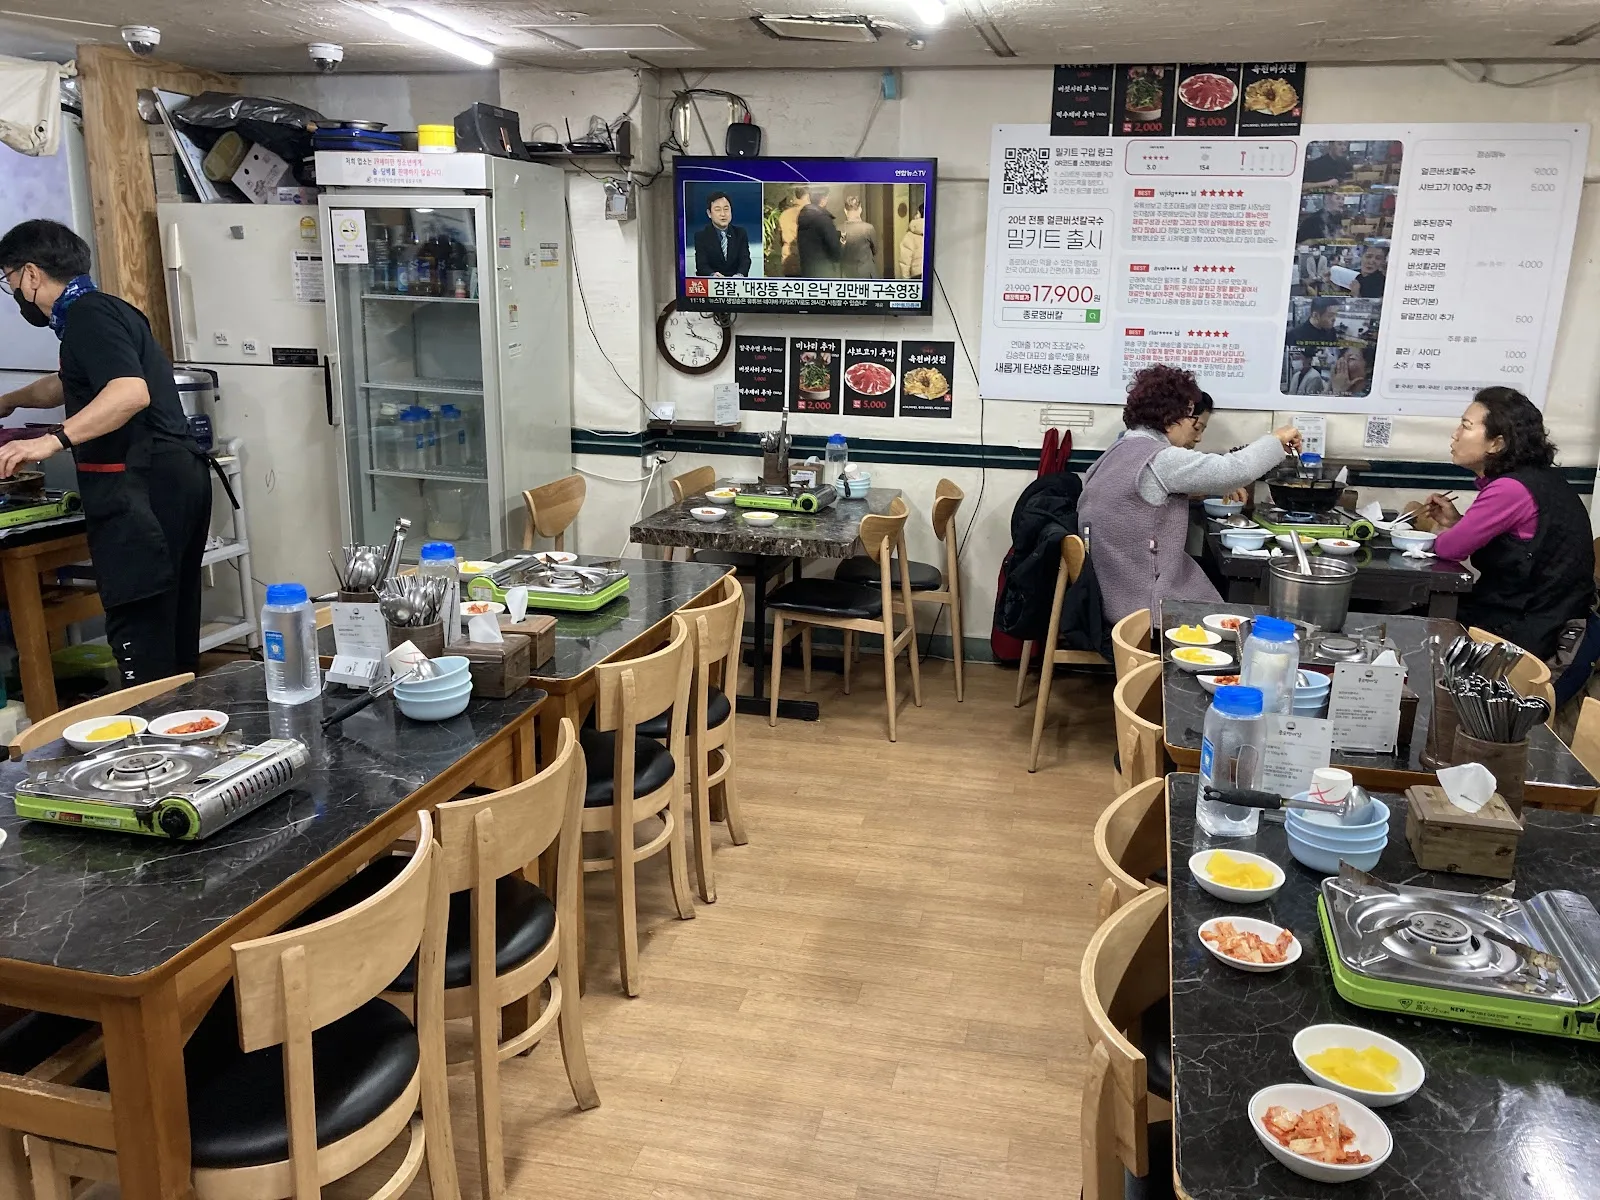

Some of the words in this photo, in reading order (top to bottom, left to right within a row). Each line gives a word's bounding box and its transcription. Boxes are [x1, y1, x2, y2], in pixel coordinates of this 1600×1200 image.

[1082, 110, 1095, 118] 추가
[1199, 117, 1226, 128] 5,000
[1134, 122, 1162, 132] 2,000
[1056, 148, 1078, 156] 밀키트
[1081, 148, 1096, 157] 구입
[1098, 148, 1112, 157] 링크
[358, 158, 372, 166] 업소는
[1421, 168, 1476, 176] 얼큰버섯칼국수
[1453, 184, 1472, 193] 100g
[1475, 184, 1492, 192] 추가
[1008, 216, 1026, 224] 20년
[1028, 216, 1044, 224] 전통
[1047, 216, 1104, 226] 얼큰버섯칼국수
[1414, 220, 1452, 228] 배추된장국
[1008, 229, 1060, 249] 밀키트
[1066, 229, 1102, 250] 출시
[1412, 234, 1434, 242] 미역국
[714, 282, 740, 298] 검찰,
[742, 282, 780, 298] '대장동
[782, 283, 804, 298] 수익
[807, 282, 834, 298] 은닉'
[836, 283, 869, 299] 김만배
[872, 284, 920, 300] 구속영장
[1404, 284, 1435, 292] 버섯라면
[1033, 286, 1100, 304] 17,900원
[1402, 298, 1438, 306] 라면(기본)
[1024, 310, 1064, 320] 종로맹버칼
[1439, 314, 1454, 322] 추가
[670, 318, 678, 326] 10
[665, 331, 671, 339] 9
[717, 332, 722, 340] 3
[670, 344, 676, 352] 8
[761, 345, 772, 353] 추가
[796, 342, 818, 350] 미나리
[820, 342, 836, 352] 추가
[847, 347, 876, 358] 샤브고기
[880, 348, 895, 358] 추가
[1418, 348, 1441, 356] 사이다
[680, 354, 685, 362] 7
[692, 358, 698, 366] 6
[706, 354, 711, 362] 5
[761, 366, 772, 374] 추가
[995, 362, 1022, 374] 새롭게
[1024, 364, 1050, 374] 탄생한
[1053, 364, 1100, 376] 종로맹버칼
[1393, 362, 1408, 370] 소주
[761, 388, 772, 396] 추가
[808, 401, 831, 410] 2,000
[863, 400, 886, 409] 5,000
[1450, 1006, 1466, 1014] NEW
